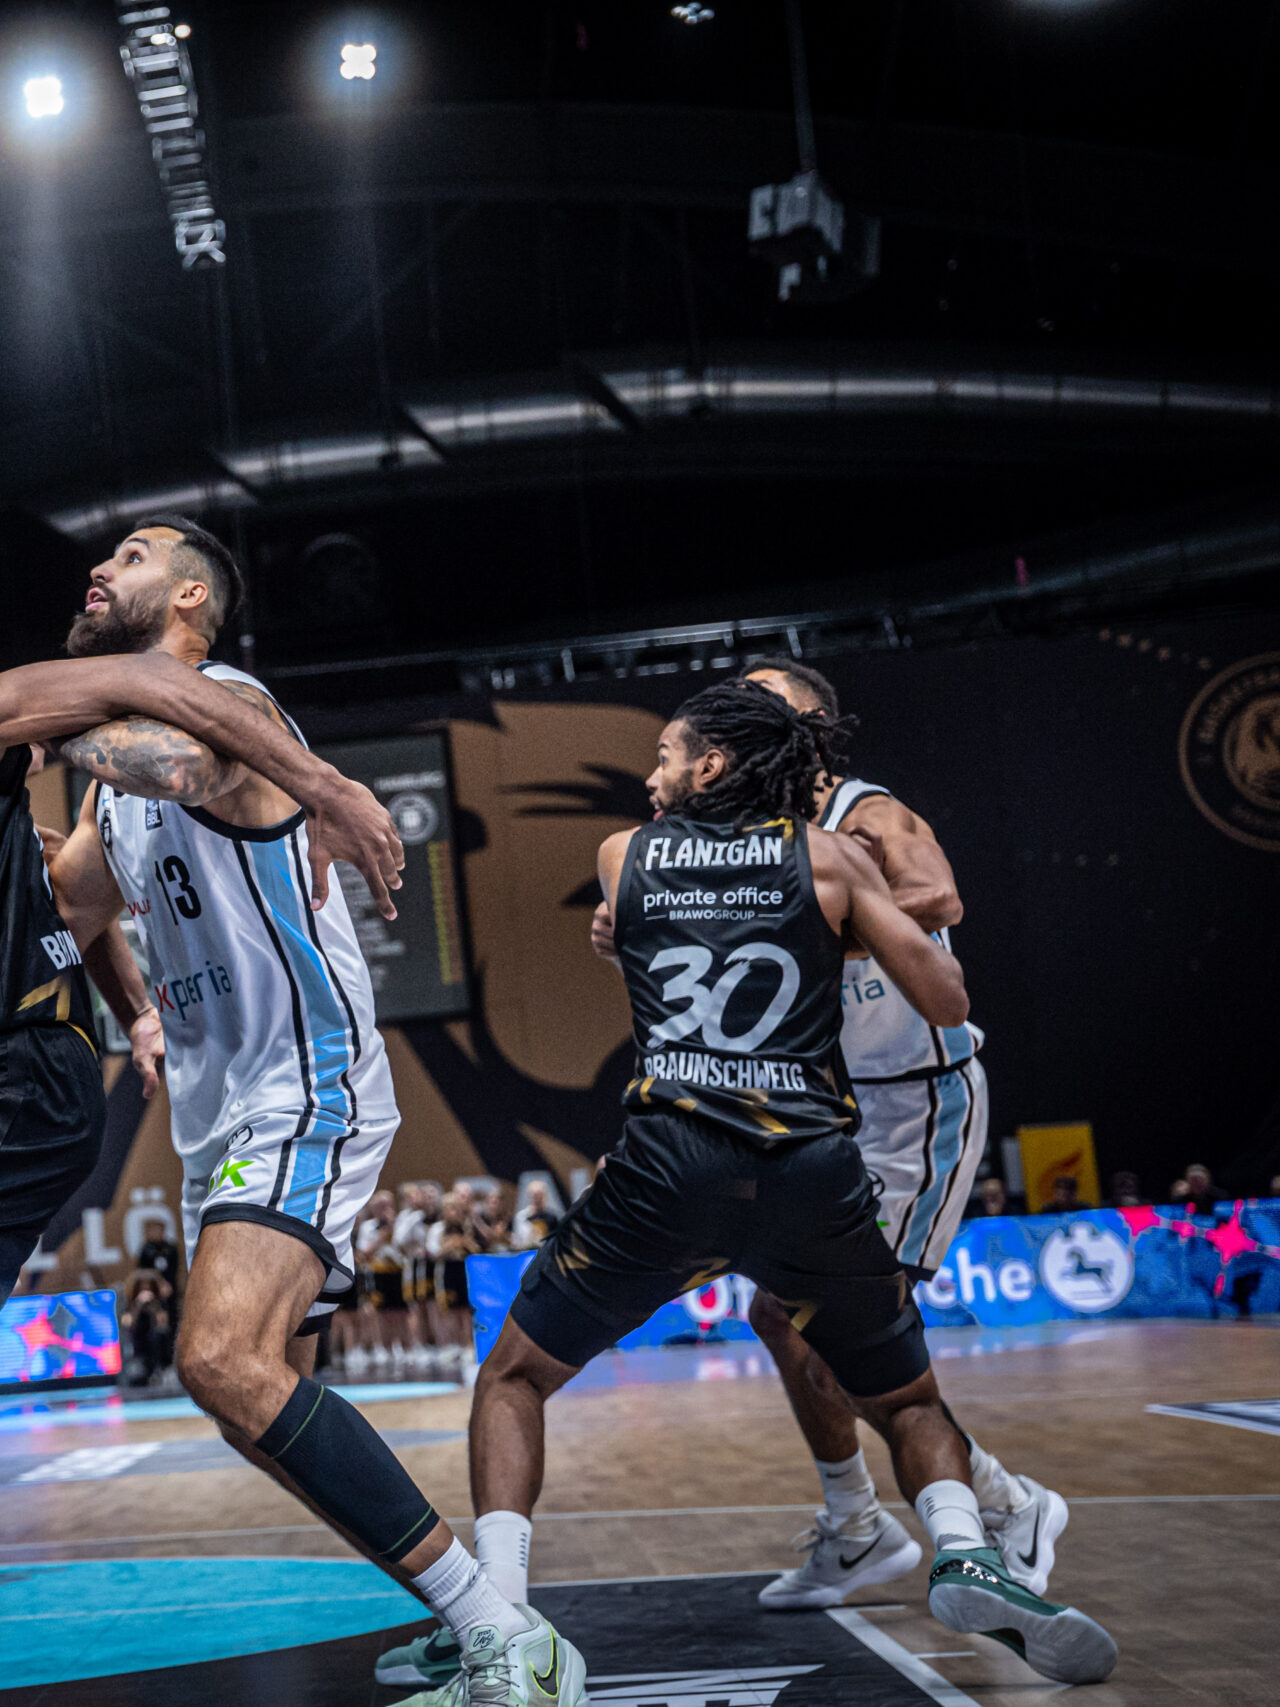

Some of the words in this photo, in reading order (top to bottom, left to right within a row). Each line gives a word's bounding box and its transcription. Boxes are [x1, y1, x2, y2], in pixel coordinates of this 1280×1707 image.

[645, 834, 783, 871] FLANIGAN
[154, 855, 202, 926] 13
[643, 889, 717, 912] private
[723, 886, 784, 905] office
[669, 909, 756, 921] BRAWOGROUP
[154, 960, 232, 1021] xperia
[646, 941, 801, 1053] 30
